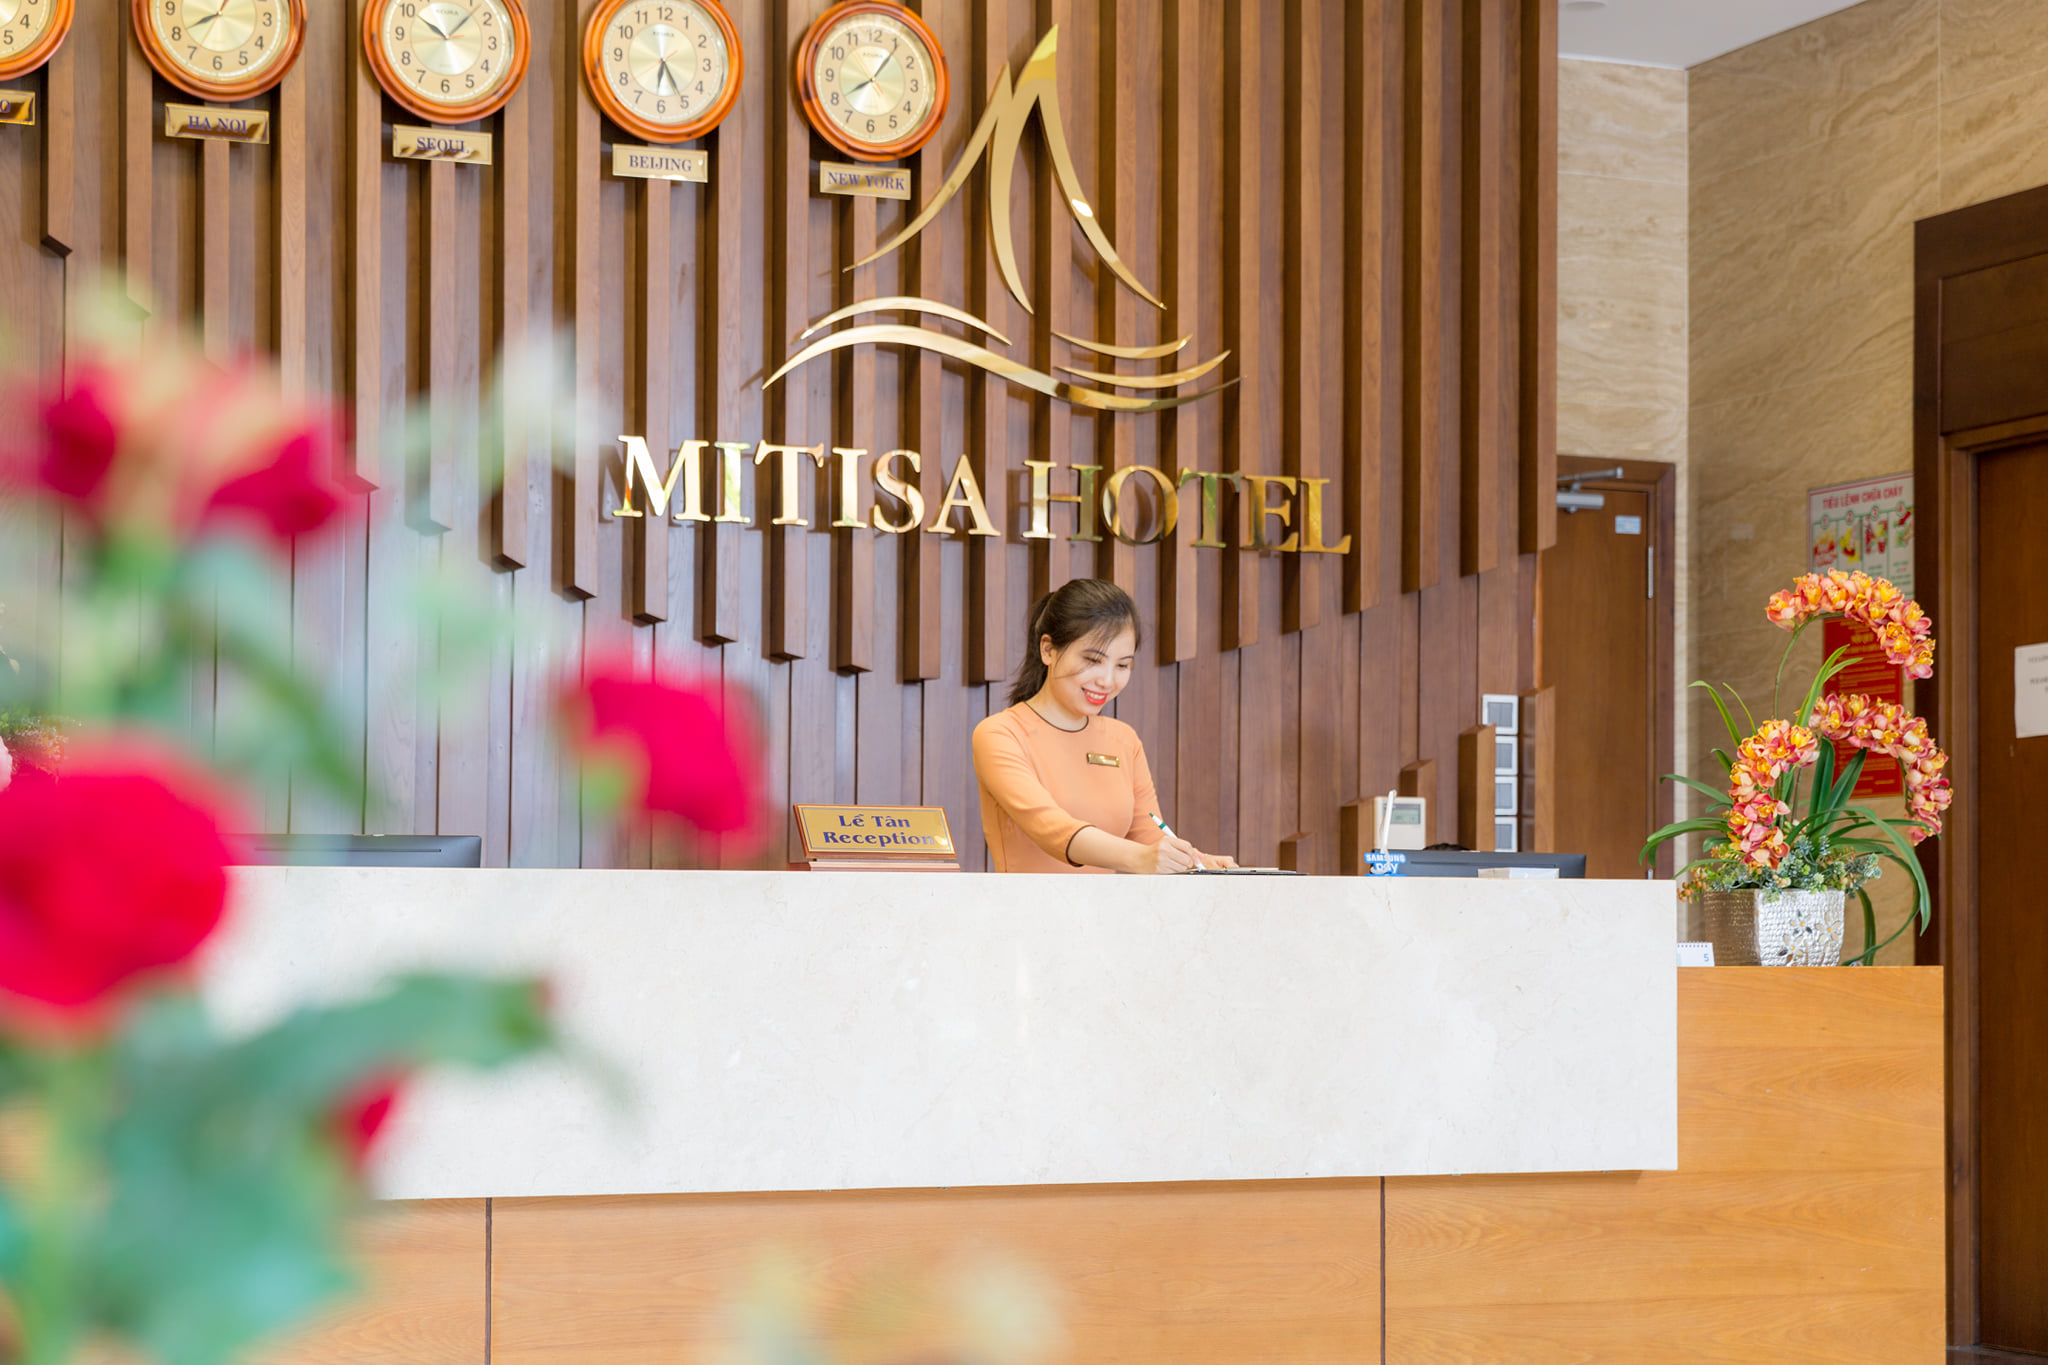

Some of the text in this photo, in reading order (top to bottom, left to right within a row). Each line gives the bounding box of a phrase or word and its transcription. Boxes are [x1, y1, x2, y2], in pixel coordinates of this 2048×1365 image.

[165, 0, 176, 16] 9
[400, 3, 416, 18] 10
[657, 6, 673, 21] 12
[19, 14, 30, 29] 4
[262, 11, 273, 27] 3
[482, 11, 493, 26] 2
[635, 10, 648, 24] 11
[3, 29, 14, 45] 5
[171, 25, 182, 42] 8
[395, 26, 405, 41] 9
[618, 25, 634, 39] 10
[846, 31, 859, 46] 11
[868, 29, 883, 44] 12
[254, 35, 264, 50] 4
[487, 37, 498, 51] 3
[697, 34, 707, 49] 2
[187, 45, 198, 60] 7
[238, 50, 249, 66] 5
[401, 50, 411, 66] 8
[613, 47, 623, 62] 9
[830, 46, 845, 61] 10
[212, 55, 223, 71] 6
[480, 59, 490, 73] 4
[702, 57, 712, 73] 3
[905, 55, 915, 70] 2
[416, 69, 427, 84] 7
[465, 73, 475, 89] 5
[618, 71, 629, 86] 8
[825, 68, 835, 82] 9
[440, 79, 450, 93] 6
[695, 80, 704, 94] 4
[910, 78, 919, 93] 3
[634, 89, 643, 104] 7
[679, 94, 690, 109] 5
[830, 91, 840, 106] 8
[656, 99, 666, 114] 6
[902, 100, 912, 115] 4
[844, 109, 854, 124] 7
[888, 114, 898, 129] 5
[187, 115, 248, 134] HA NOI
[865, 119, 875, 133] 6
[416, 136, 470, 154] SEOUL
[629, 155, 692, 171] BEIJING
[828, 172, 905, 190] NEW YORK
[613, 435, 1351, 555] MITISA HOTEL
[870, 814, 911, 828] Tân
[823, 831, 935, 847] Reception
[1703, 953, 1710, 963] 5
